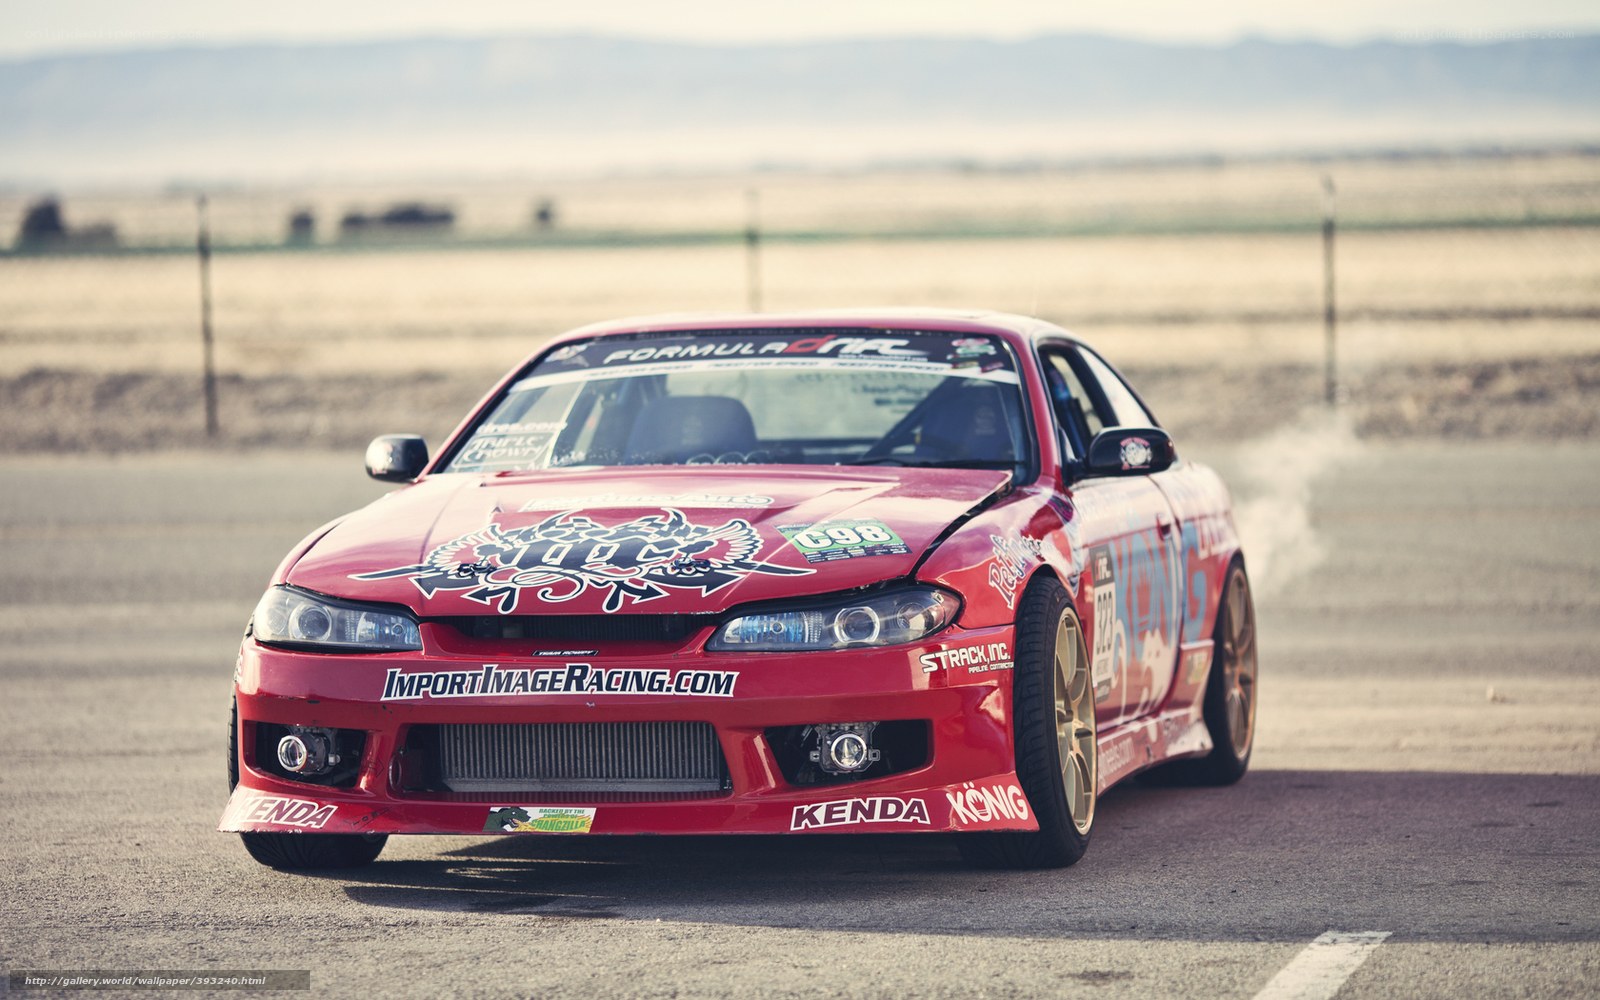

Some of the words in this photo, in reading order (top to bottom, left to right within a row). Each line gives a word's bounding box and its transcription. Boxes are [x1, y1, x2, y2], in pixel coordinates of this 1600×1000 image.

[602, 341, 789, 364] FORMULA
[792, 525, 893, 548] C98
[790, 797, 931, 831] KENDA
[945, 781, 1029, 825] KÖNIG
